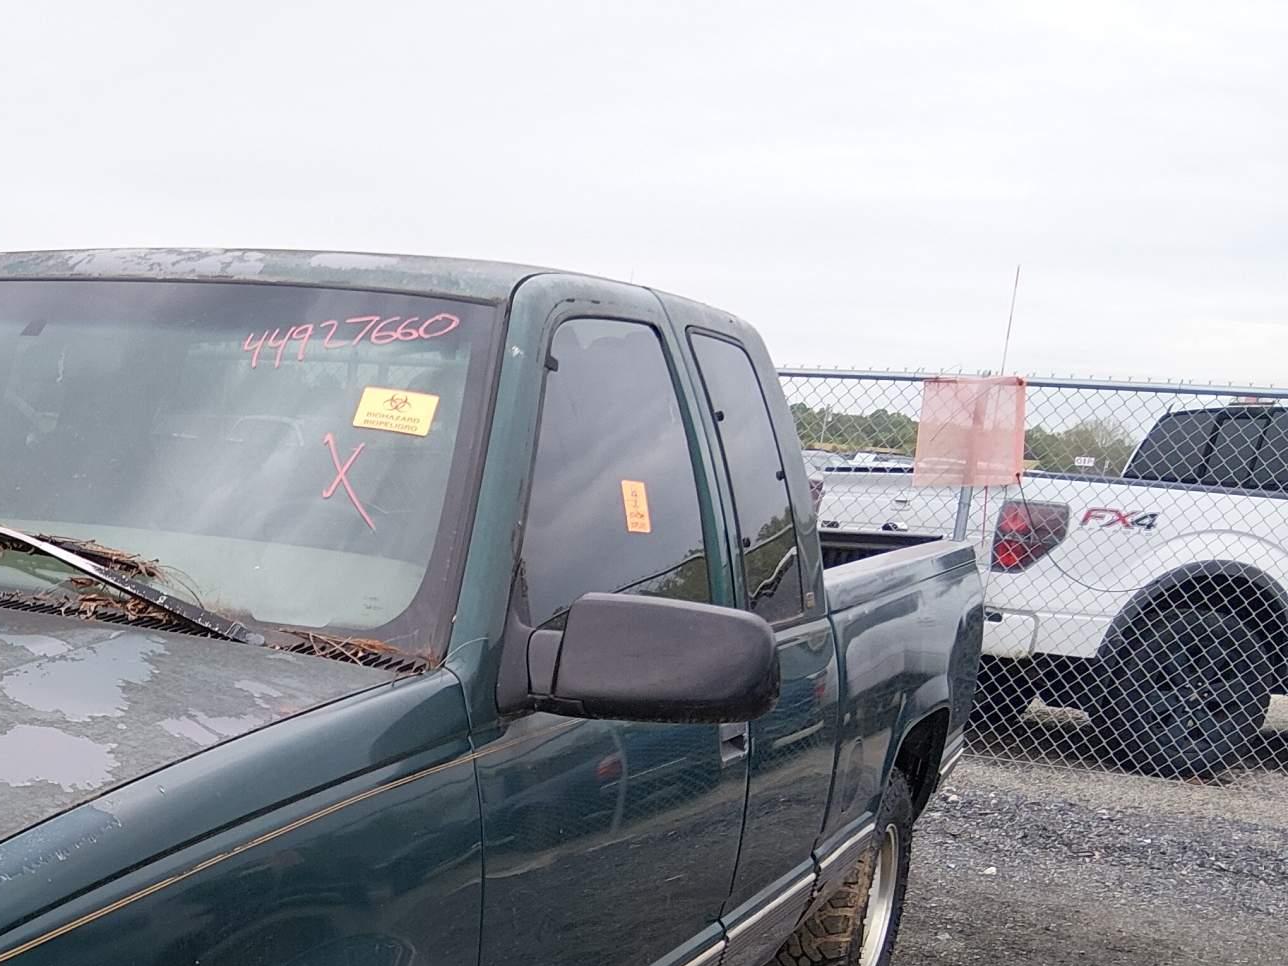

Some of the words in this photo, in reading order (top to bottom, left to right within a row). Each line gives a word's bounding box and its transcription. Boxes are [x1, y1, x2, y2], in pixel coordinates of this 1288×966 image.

[242, 312, 461, 369] 44927660
[362, 418, 419, 432] BIOPELIGRO
[365, 411, 421, 424] BIOHAZARD
[321, 431, 376, 532] X
[1079, 507, 1160, 530] FX4
